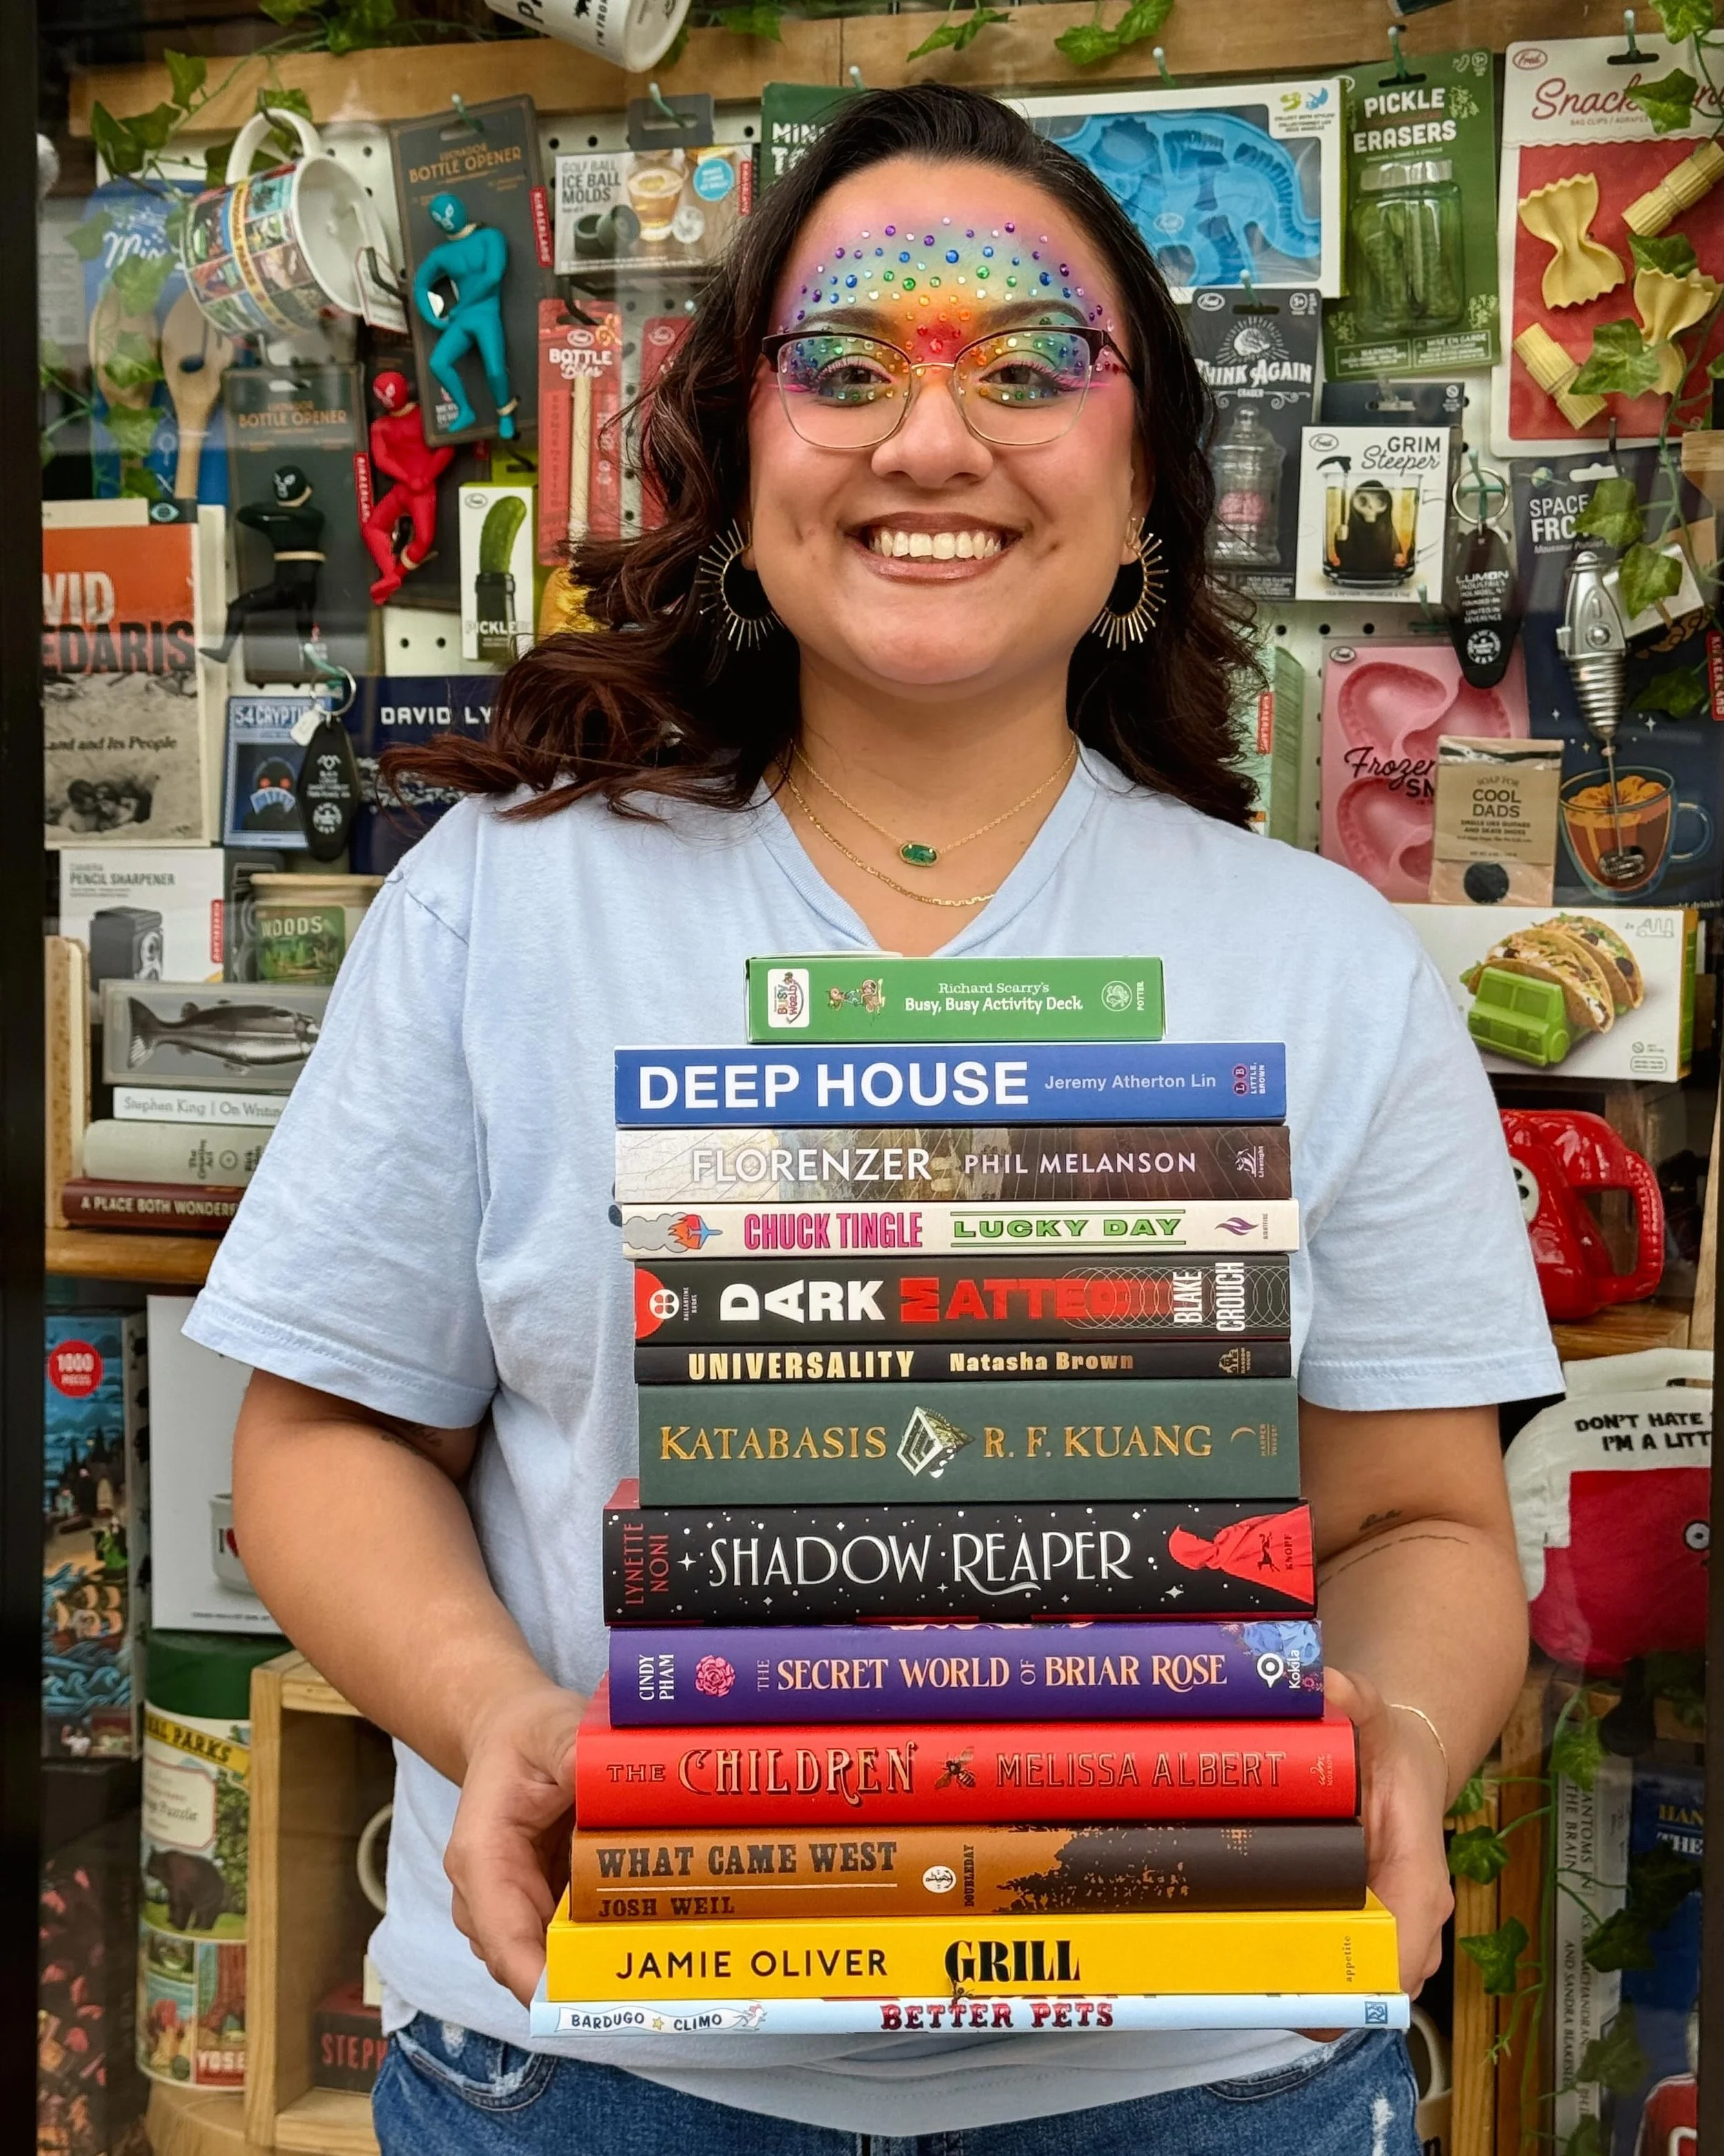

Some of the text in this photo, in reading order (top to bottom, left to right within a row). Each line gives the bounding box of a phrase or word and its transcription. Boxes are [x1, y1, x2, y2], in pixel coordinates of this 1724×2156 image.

[1363, 87, 1446, 119] PICKLE
[1353, 120, 1457, 154] ERASERS
[408, 159, 460, 183] BOTTLE
[465, 146, 522, 171] OPENER
[562, 172, 621, 189] ICE BALL
[562, 188, 611, 204] MOLDS
[549, 348, 613, 365] BOTTLE
[1250, 359, 1312, 388] AGAIN
[291, 410, 347, 425] OPENER
[1387, 436, 1441, 453] GRIM
[1361, 445, 1441, 478] Steeper
[1529, 494, 1590, 518] SPACE
[1530, 514, 1590, 543] FRO
[233, 705, 255, 724] 54
[380, 705, 452, 726] DAVID
[77, 736, 105, 752] and
[128, 735, 178, 754] People
[1472, 788, 1522, 804] COOL
[1472, 803, 1521, 818] DADS
[70, 872, 176, 886] PENCIL SHARPENER
[261, 914, 323, 936] WOODS
[939, 981, 1050, 996] Richard Scarry's
[1136, 980, 1145, 1011] POTTER
[905, 995, 1083, 1016] Busy, Busy Activity Deck
[639, 1060, 1029, 1110] DEEP HOUSE
[1044, 1072, 1216, 1093] Jeremy Atherton Lin
[1250, 1062, 1258, 1094] LITTLE,
[123, 1096, 241, 1116] Stephen King On
[692, 1147, 1196, 1183] FLORENZER PHIL MELANSON
[81, 1196, 239, 1218] A PLACE BOTH WONDERF
[743, 1212, 923, 1251] CHUCK TINGLE
[953, 1218, 1182, 1238] LUCKY DAY
[719, 1279, 885, 1324] DARK
[1173, 1271, 1203, 1324] BLAKE
[1214, 1262, 1247, 1332] CROUCH
[57, 1352, 94, 1373] 1000
[688, 1350, 1134, 1380] UNIVERSALITY Natasha Brown
[1574, 1411, 1703, 1433] DON'T HATE
[659, 1424, 1214, 1461] KATABASIS R. F. KUANG
[1601, 1435, 1634, 1452] I'M
[1641, 1433, 1657, 1451] A
[623, 1522, 644, 1606] LYNETTE
[649, 1533, 670, 1593] NONI
[708, 1530, 1134, 1597] SHADOW REAPER
[1284, 1533, 1294, 1571] KNOPF
[639, 1653, 655, 1702] CINDY
[659, 1653, 674, 1702] PHAM
[756, 1655, 1228, 1693] THE SECRET WORLD OF BRIAR ROSE
[1287, 1649, 1301, 1689] Kokila
[173, 1726, 232, 1763] PARKS
[605, 1763, 667, 1784] THE
[677, 1740, 919, 1810] CHILDREN
[995, 1751, 1141, 1789] MELISSA
[1150, 1750, 1287, 1789] ALBERT
[1563, 1784, 1578, 1870] THE BRAIN
[596, 1841, 899, 1879] WHAT CAME WEST
[963, 1844, 976, 1908] DOUBLEDAY
[597, 1895, 736, 1918] JOSH WEIL
[615, 1939, 1082, 1983] JAMIE OLIVER GRILL
[1345, 1935, 1353, 1983] appetite
[1563, 1972, 1576, 2024] SANDRA
[570, 2012, 723, 2032] BARDUGO CLIMO
[880, 2001, 1114, 2031] BETTER PETS
